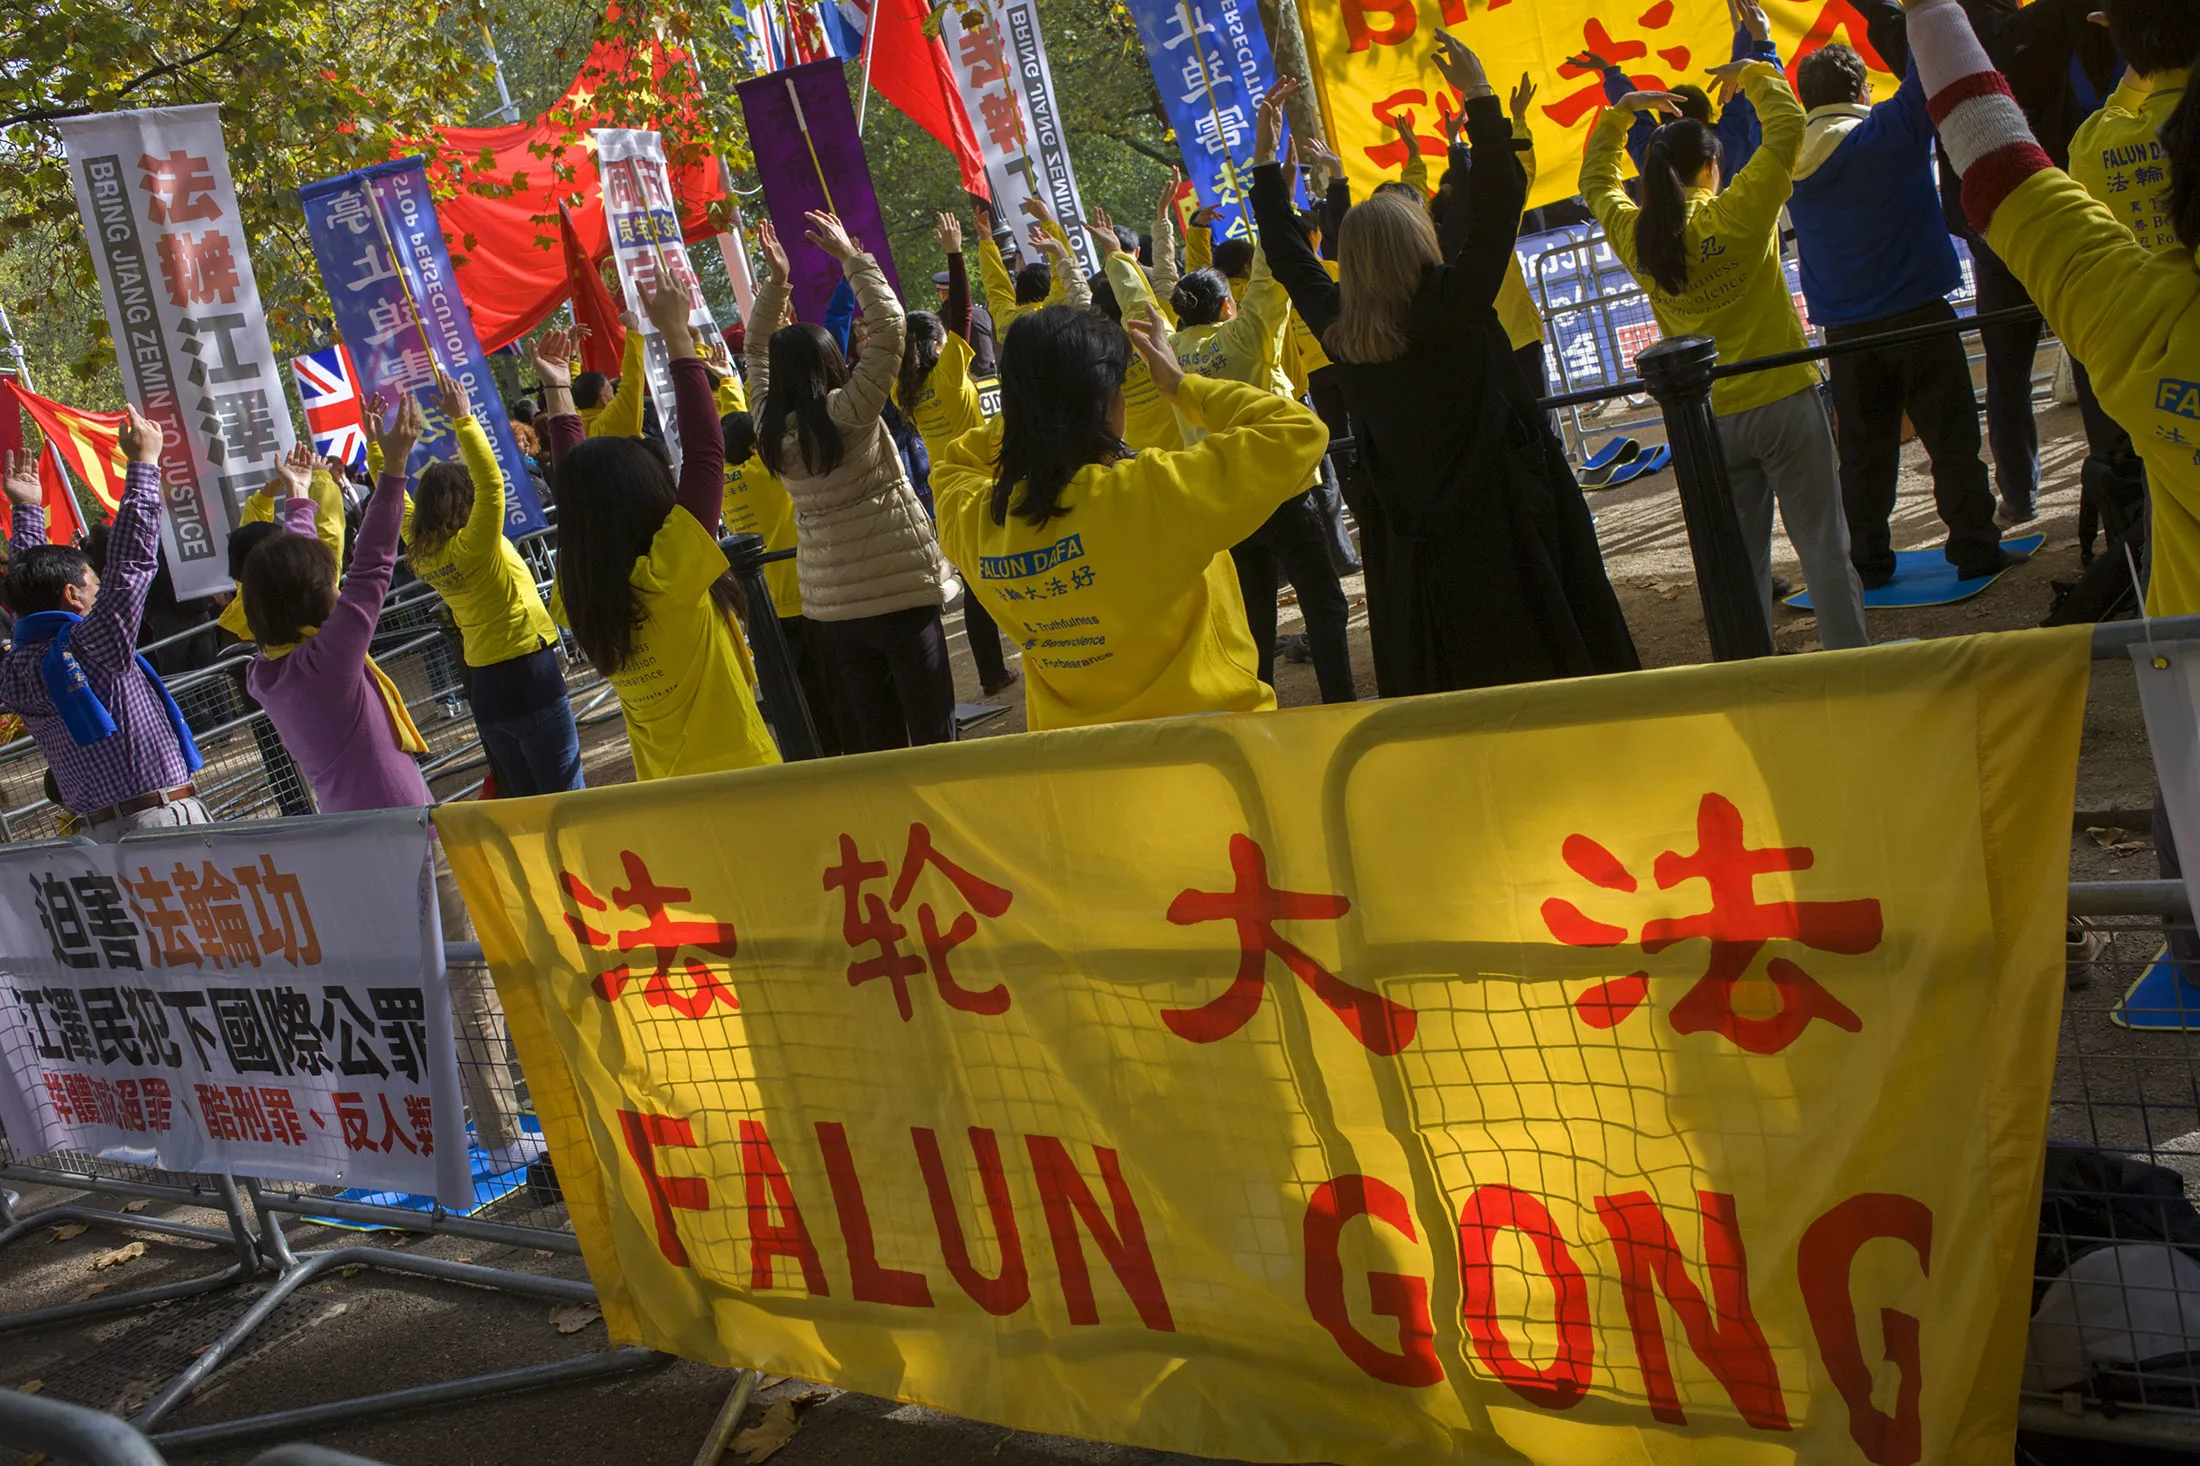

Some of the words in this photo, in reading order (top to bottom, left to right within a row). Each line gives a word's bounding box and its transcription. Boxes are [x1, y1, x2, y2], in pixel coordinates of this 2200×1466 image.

[2102, 143, 2147, 169] FALUN
[88, 161, 131, 243] BRING
[112, 249, 151, 324] JIANG
[132, 332, 172, 409] ZEMIN
[161, 411, 182, 449] TO
[162, 454, 208, 557] JUSTICE
[980, 557, 1028, 578] FALUN
[1033, 539, 1082, 572] DAFA
[1036, 616, 1100, 632] Truthfulness
[1041, 635, 1106, 648] Benevolence
[1042, 652, 1113, 668] Forbearance
[29, 854, 323, 972] 迫害法輪功
[559, 792, 1884, 1057] 法轮大法
[616, 1108, 1177, 1333] FALUN
[1302, 1173, 1933, 1465] GONG
